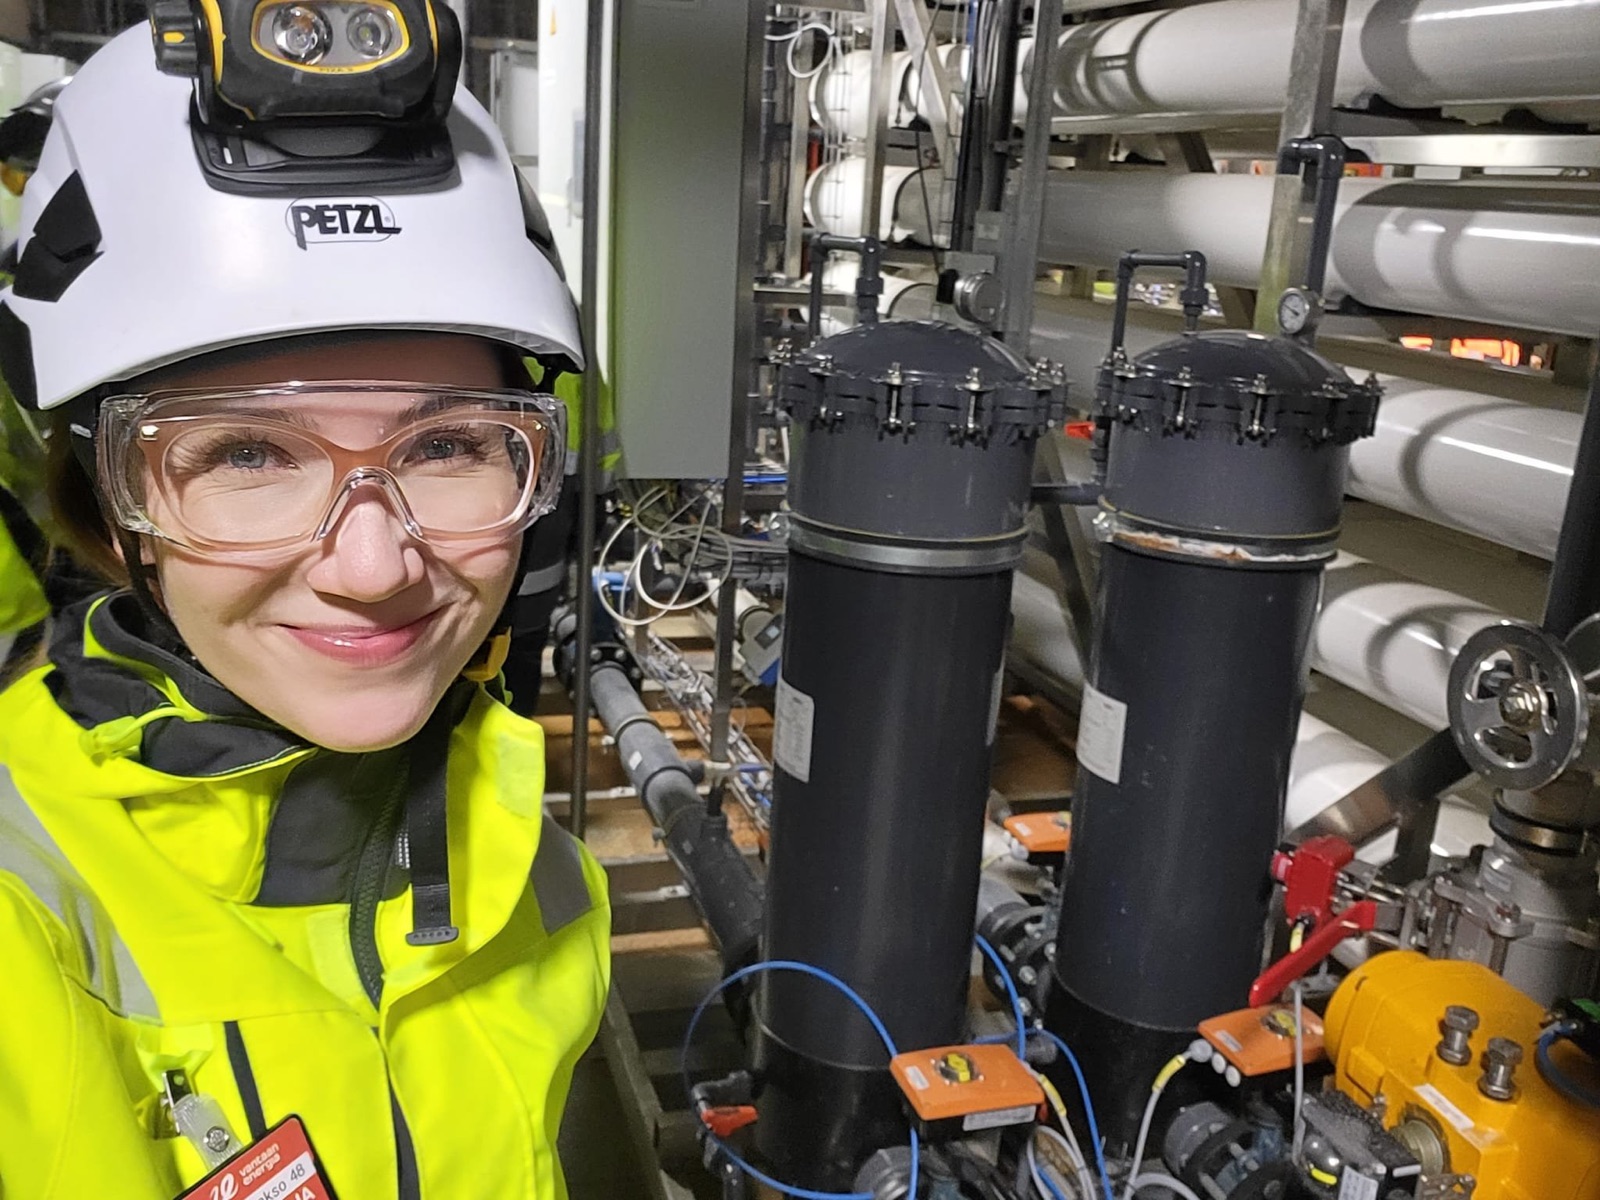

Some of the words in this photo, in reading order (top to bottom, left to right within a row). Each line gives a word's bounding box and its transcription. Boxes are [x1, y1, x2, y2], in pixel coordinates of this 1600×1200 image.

[291, 204, 402, 251] PETZL
[239, 1143, 280, 1177] vantaan
[243, 1153, 281, 1186] energia
[290, 1163, 306, 1181] 48
